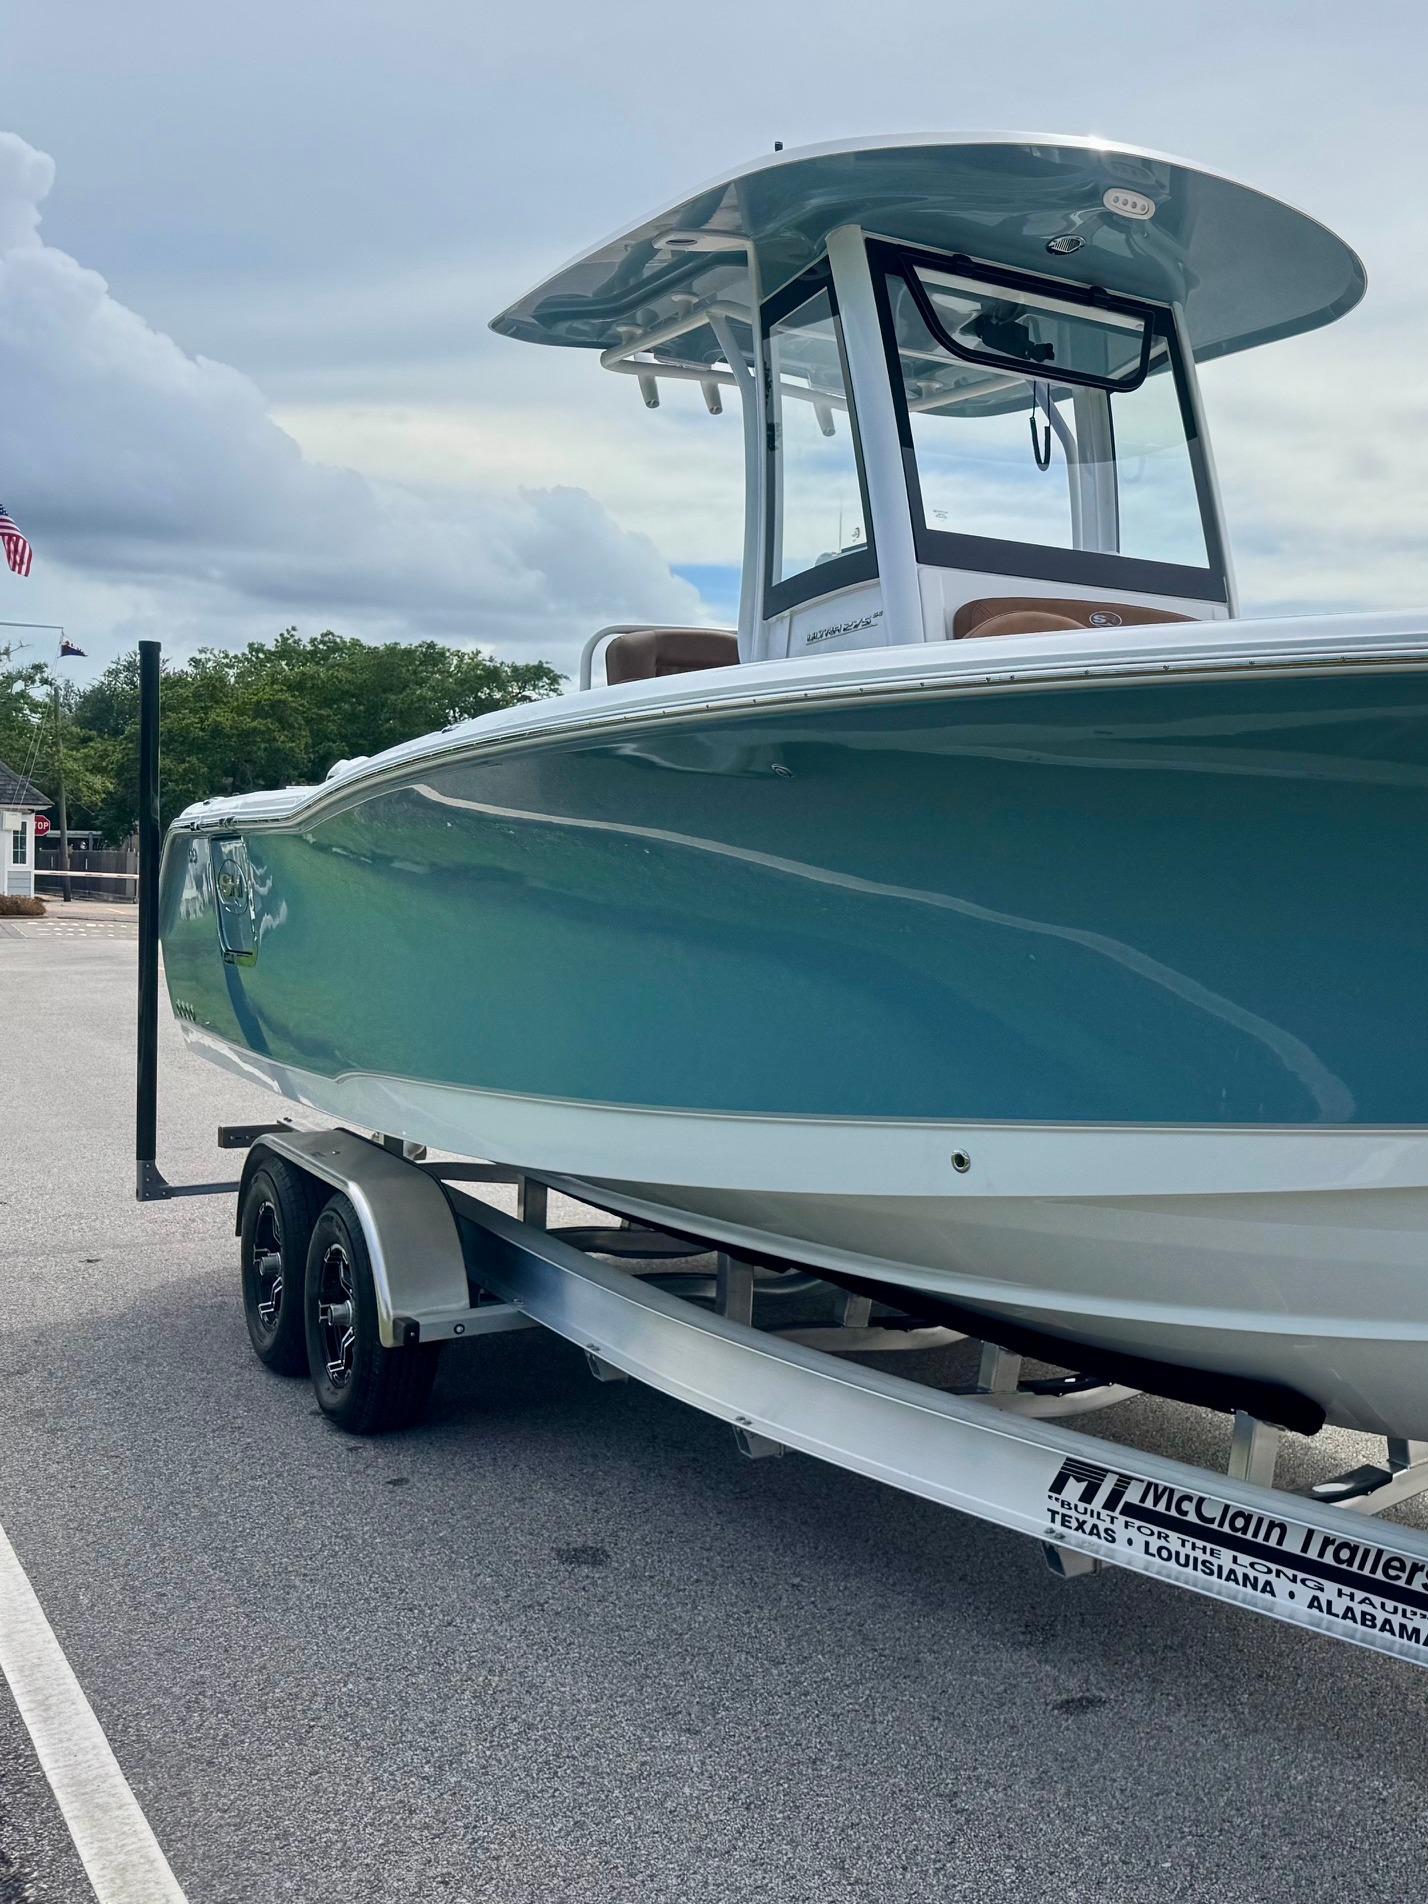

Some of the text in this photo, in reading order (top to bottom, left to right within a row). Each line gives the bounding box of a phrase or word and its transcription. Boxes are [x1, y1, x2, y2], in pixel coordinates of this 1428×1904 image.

[1138, 1479, 1288, 1548] McClain
[1047, 1508, 1117, 1545] TEXAS
[1144, 1540, 1277, 1598] LOUISIANA
[1124, 1520, 1171, 1544] FOR
[1177, 1536, 1222, 1560] THE
[1232, 1554, 1325, 1593] LONG
